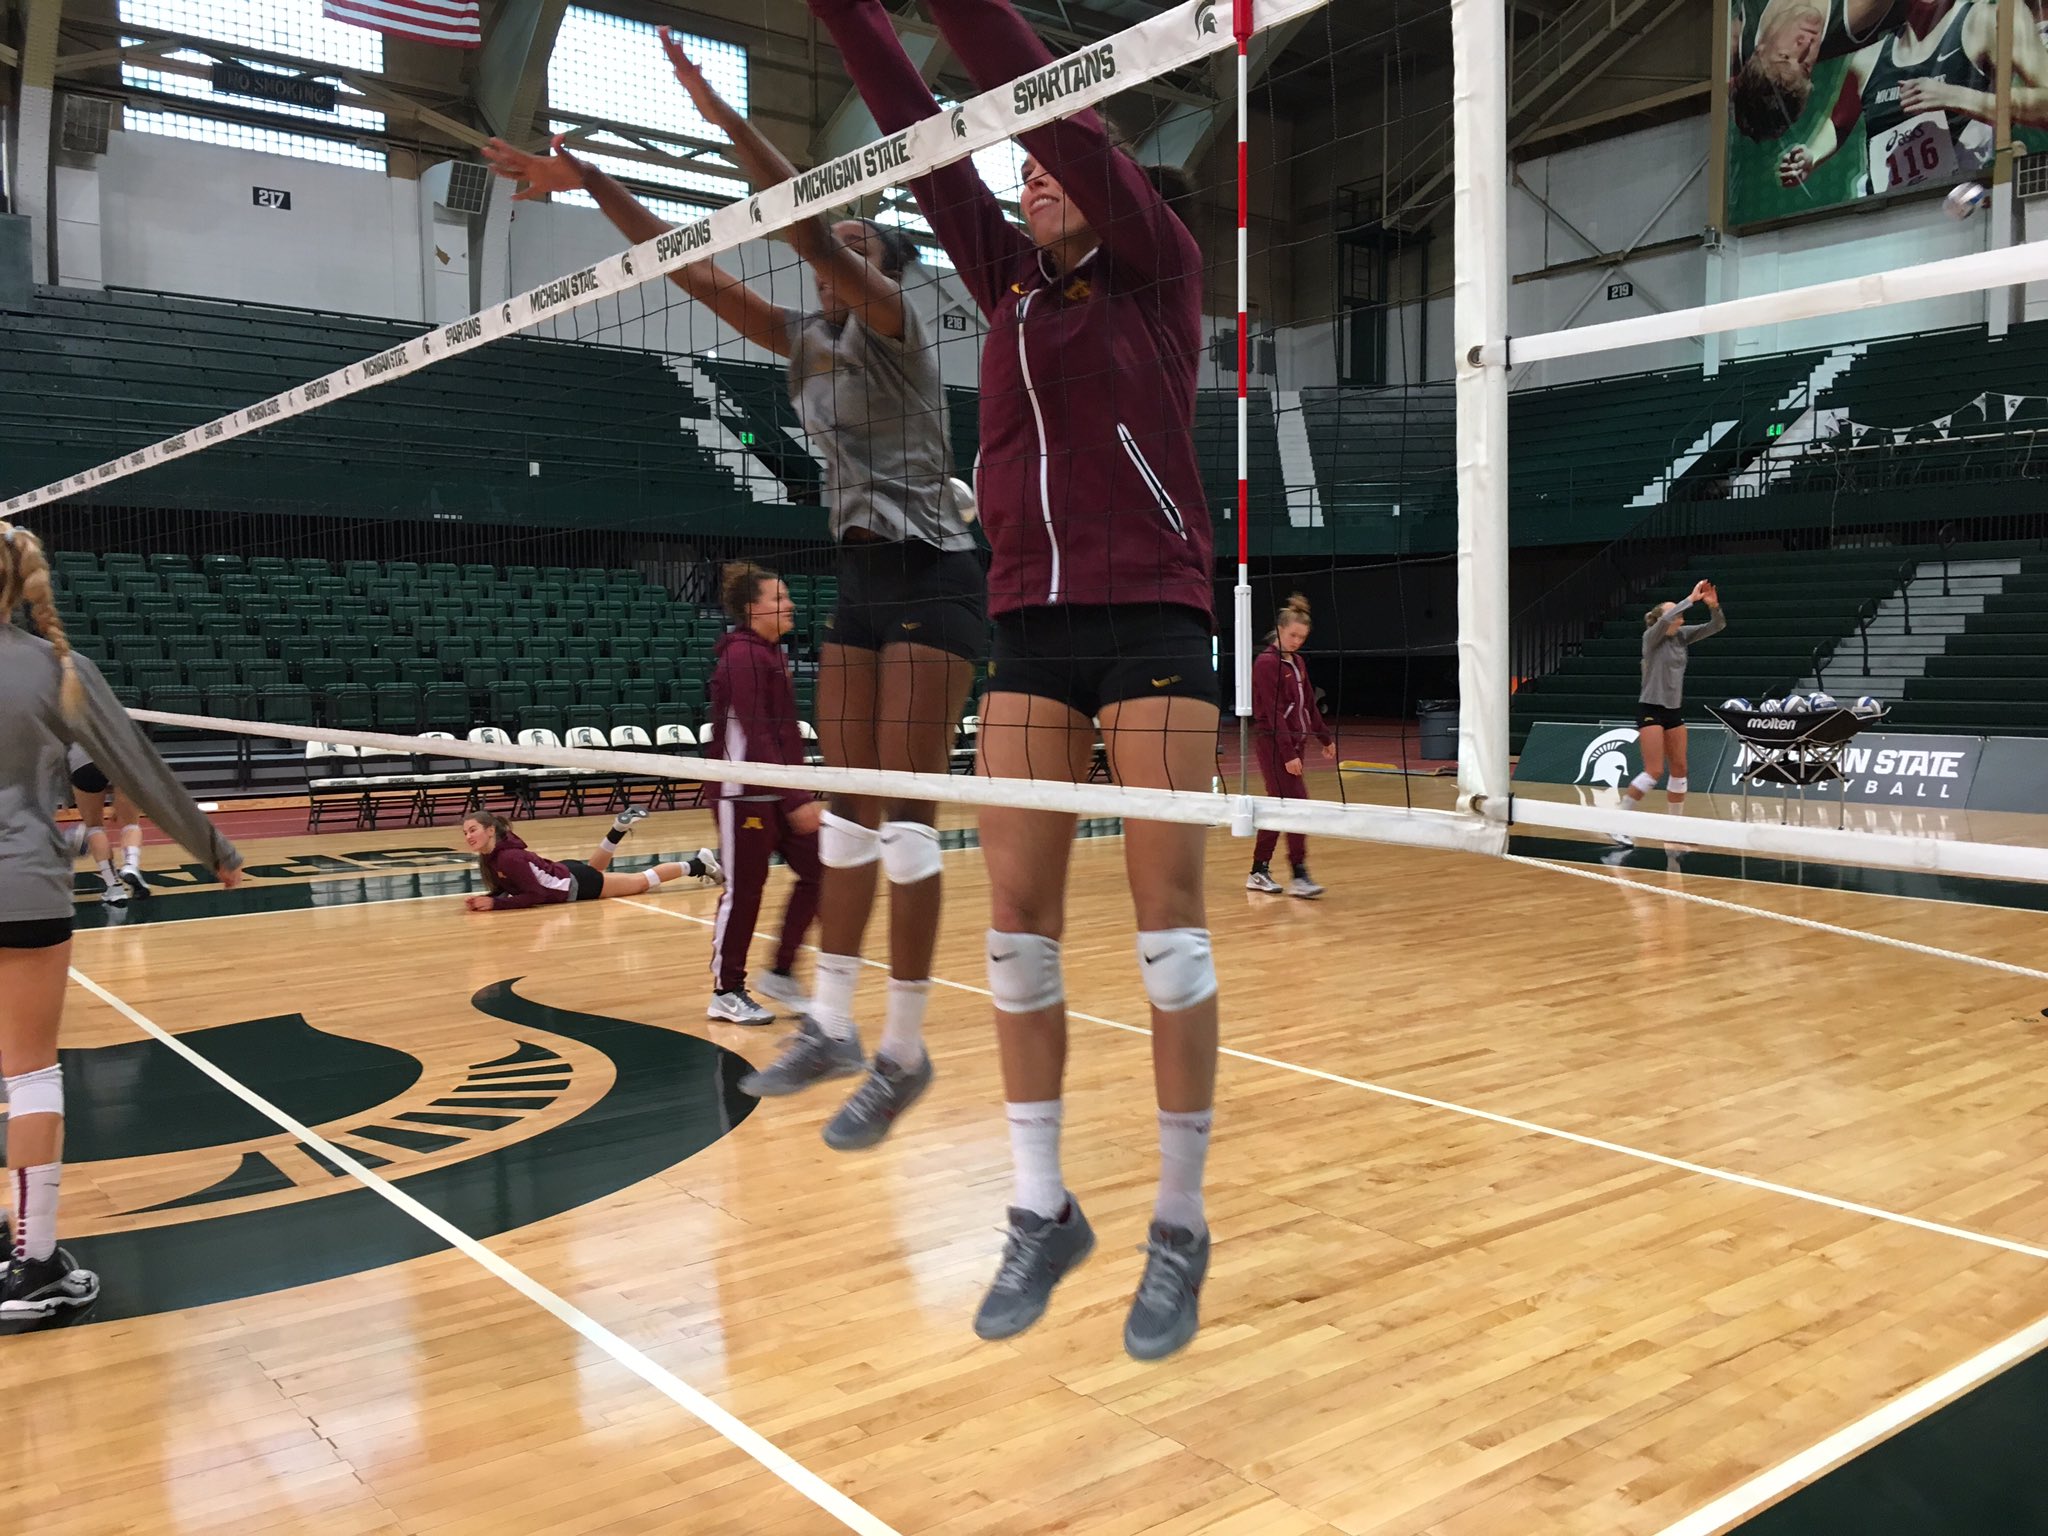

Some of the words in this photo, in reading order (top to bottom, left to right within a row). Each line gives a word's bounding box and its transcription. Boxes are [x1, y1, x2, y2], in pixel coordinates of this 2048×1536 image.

[254, 78, 326, 103] SMOKING
[1013, 43, 1116, 115] SPARTANS
[792, 153, 863, 207] MICHIGAN
[864, 132, 911, 178] STATE
[1885, 137, 1940, 186] 116
[258, 189, 285, 207] 217
[656, 218, 711, 263] SPARTANS
[529, 277, 570, 314] MICHIGAN
[570, 266, 599, 297] STATE
[1611, 284, 1629, 299] 219
[445, 316, 482, 348] SPARTANS
[946, 315, 963, 329] 218
[1746, 717, 1797, 731] molten
[1873, 749, 1966, 778] STATE
